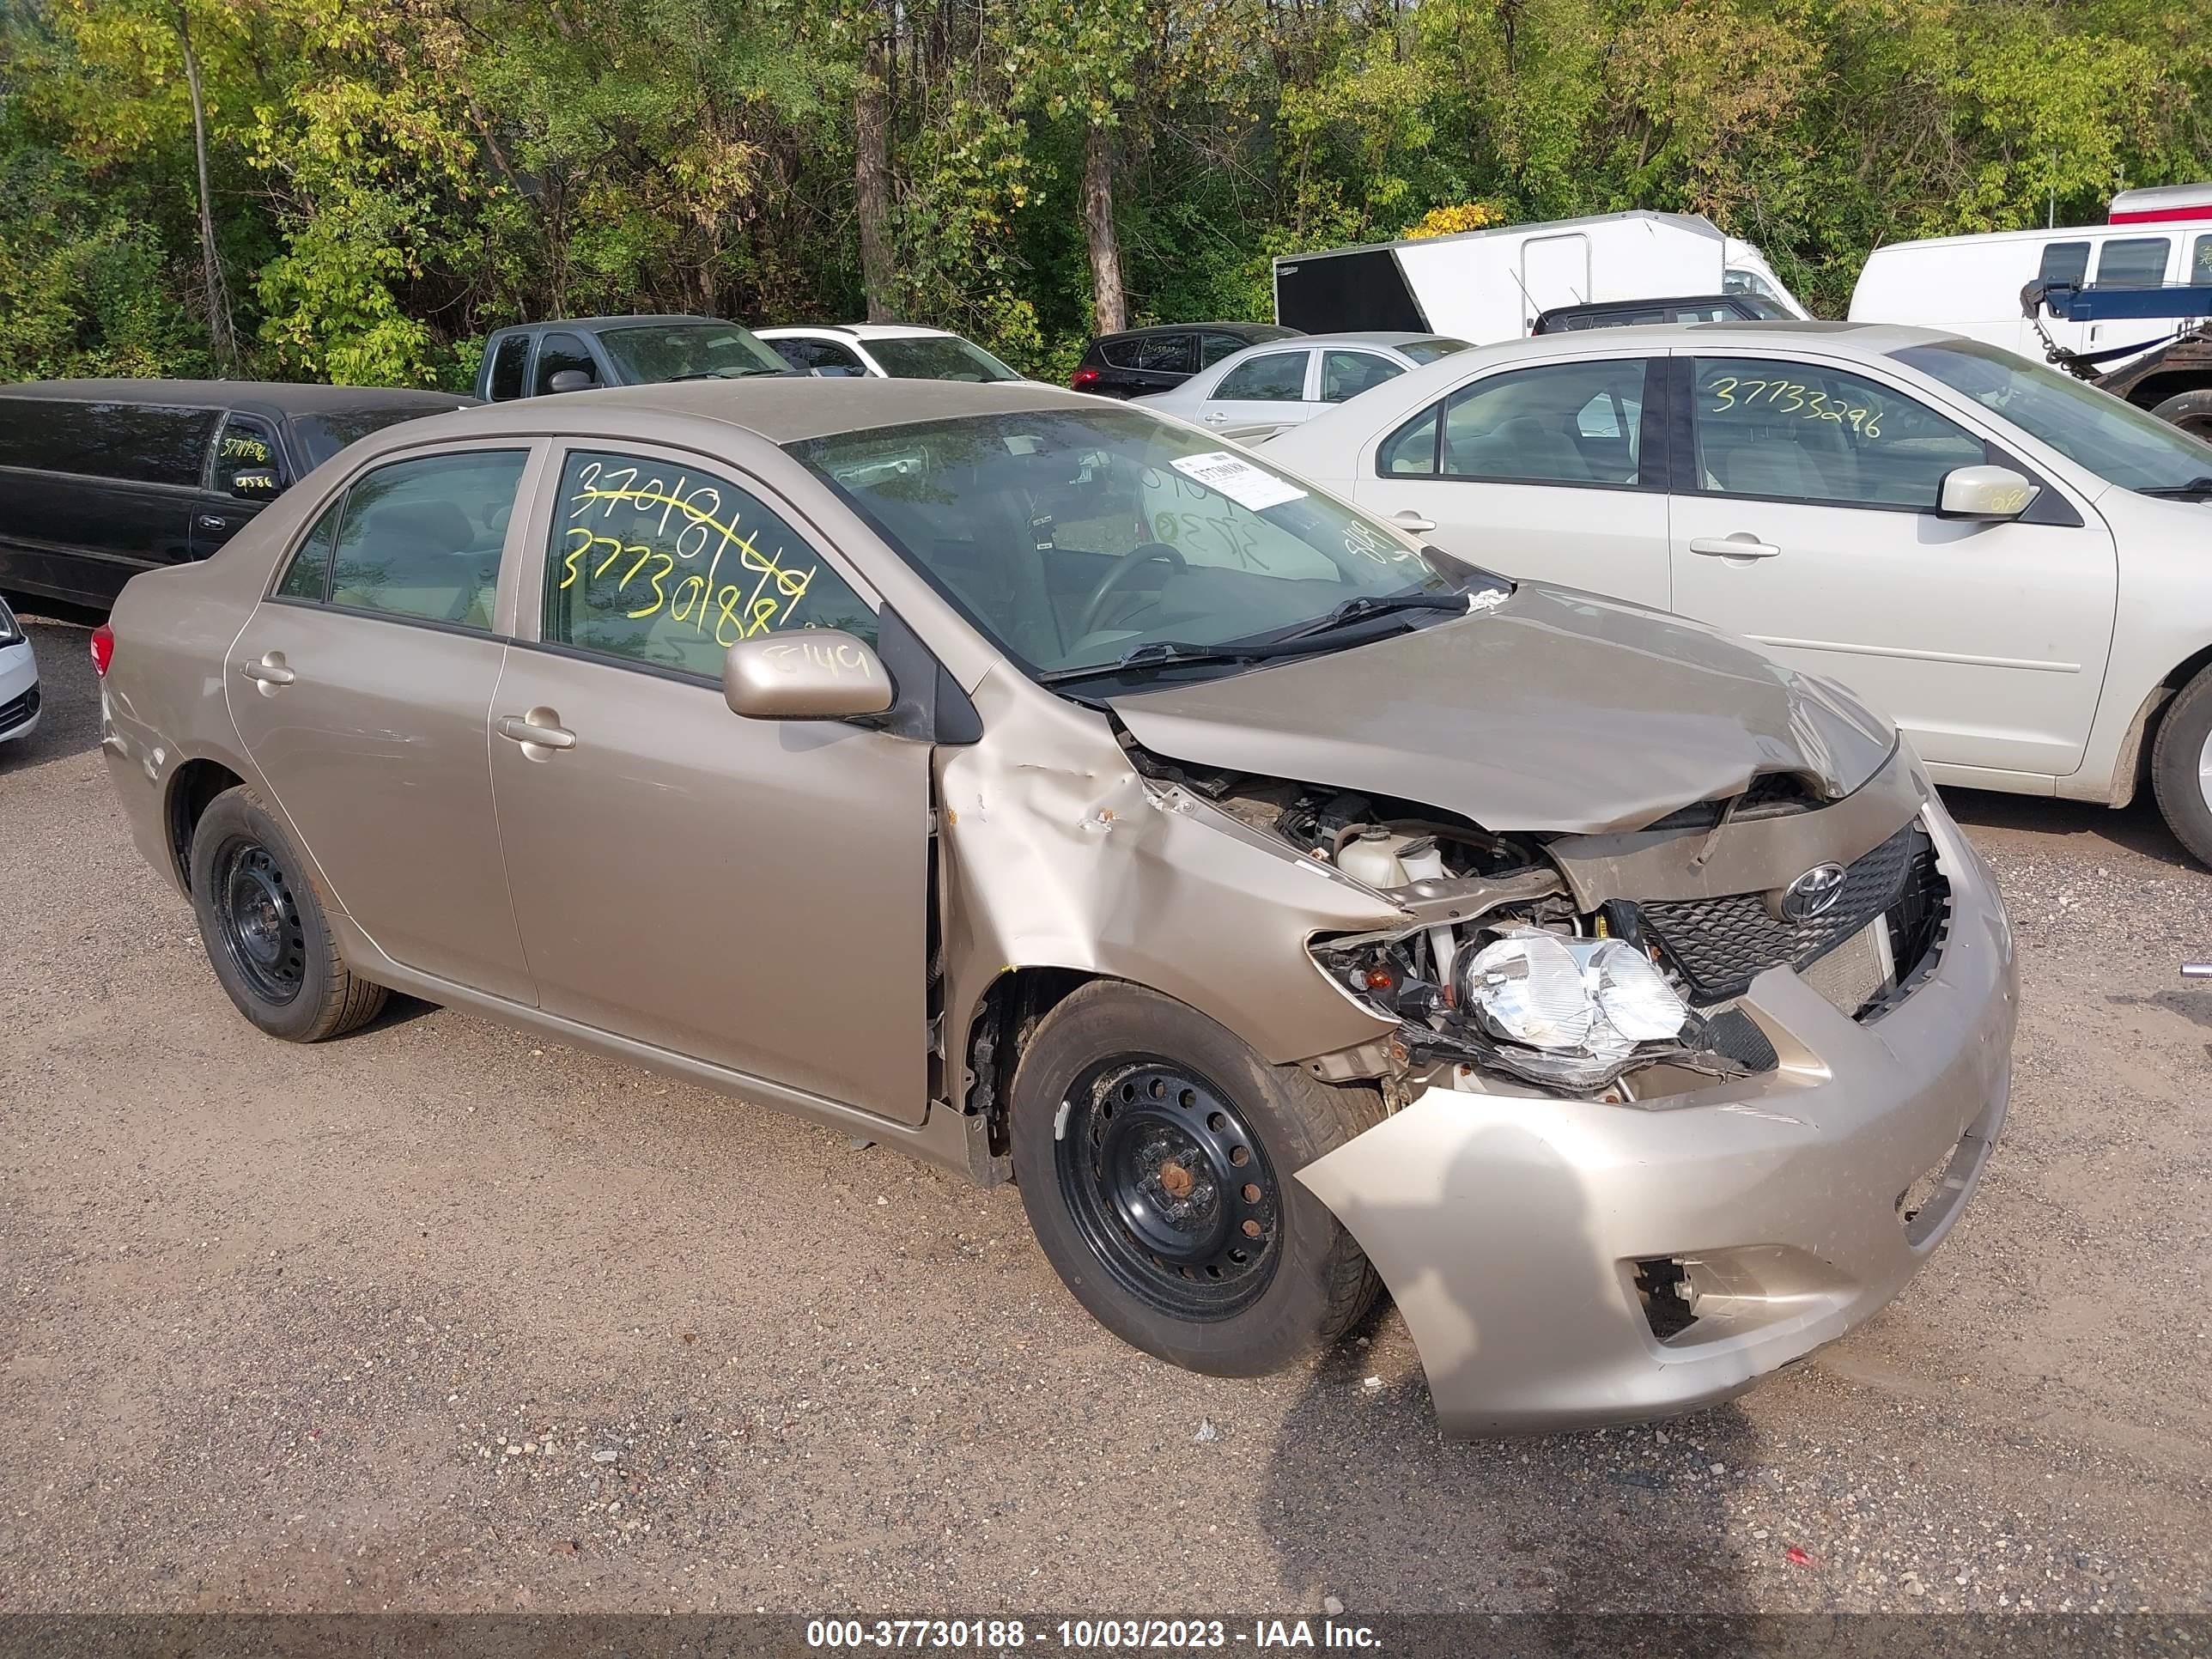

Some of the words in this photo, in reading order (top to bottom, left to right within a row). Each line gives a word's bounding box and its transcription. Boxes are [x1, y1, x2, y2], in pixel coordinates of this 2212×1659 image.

[1708, 377, 1884, 439] 37733296
[220, 438, 266, 462] 37719586
[1193, 462, 1250, 481] 37730188
[236, 476, 273, 494] 9586
